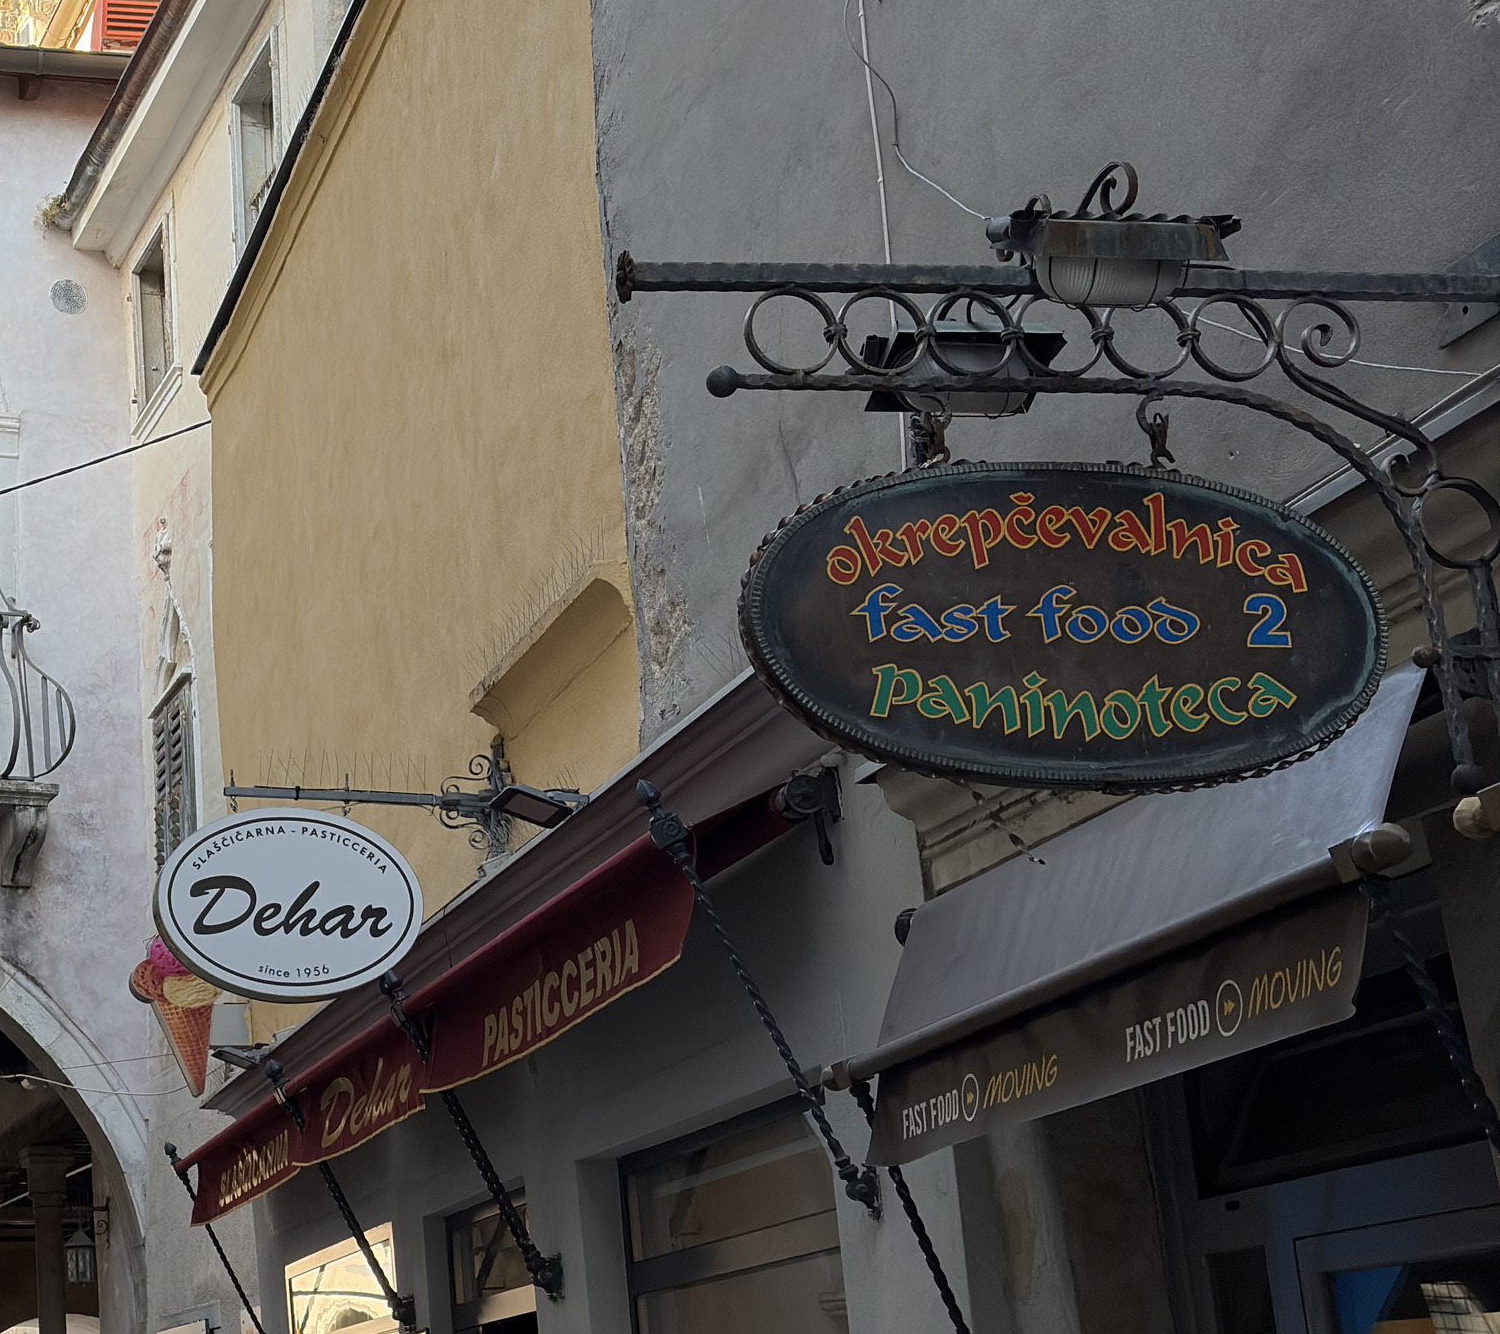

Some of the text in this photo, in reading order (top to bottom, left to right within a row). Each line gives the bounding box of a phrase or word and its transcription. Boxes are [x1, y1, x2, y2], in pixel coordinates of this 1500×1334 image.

[826, 492, 1308, 593] okrepčevalnica
[850, 583, 1293, 648] fast food 2
[192, 825, 286, 870] SLAŠČIČARNA
[301, 826, 388, 875] PASTICCERIA
[190, 875, 393, 939] Dehar
[258, 964, 330, 979] since 1956
[1125, 946, 1343, 1062] FAST FOOD MOVING
[320, 1057, 412, 1148] Dehar
[482, 918, 639, 1068] PASTICCERIA
[902, 1054, 1058, 1140] FAST FOOD MOVING
